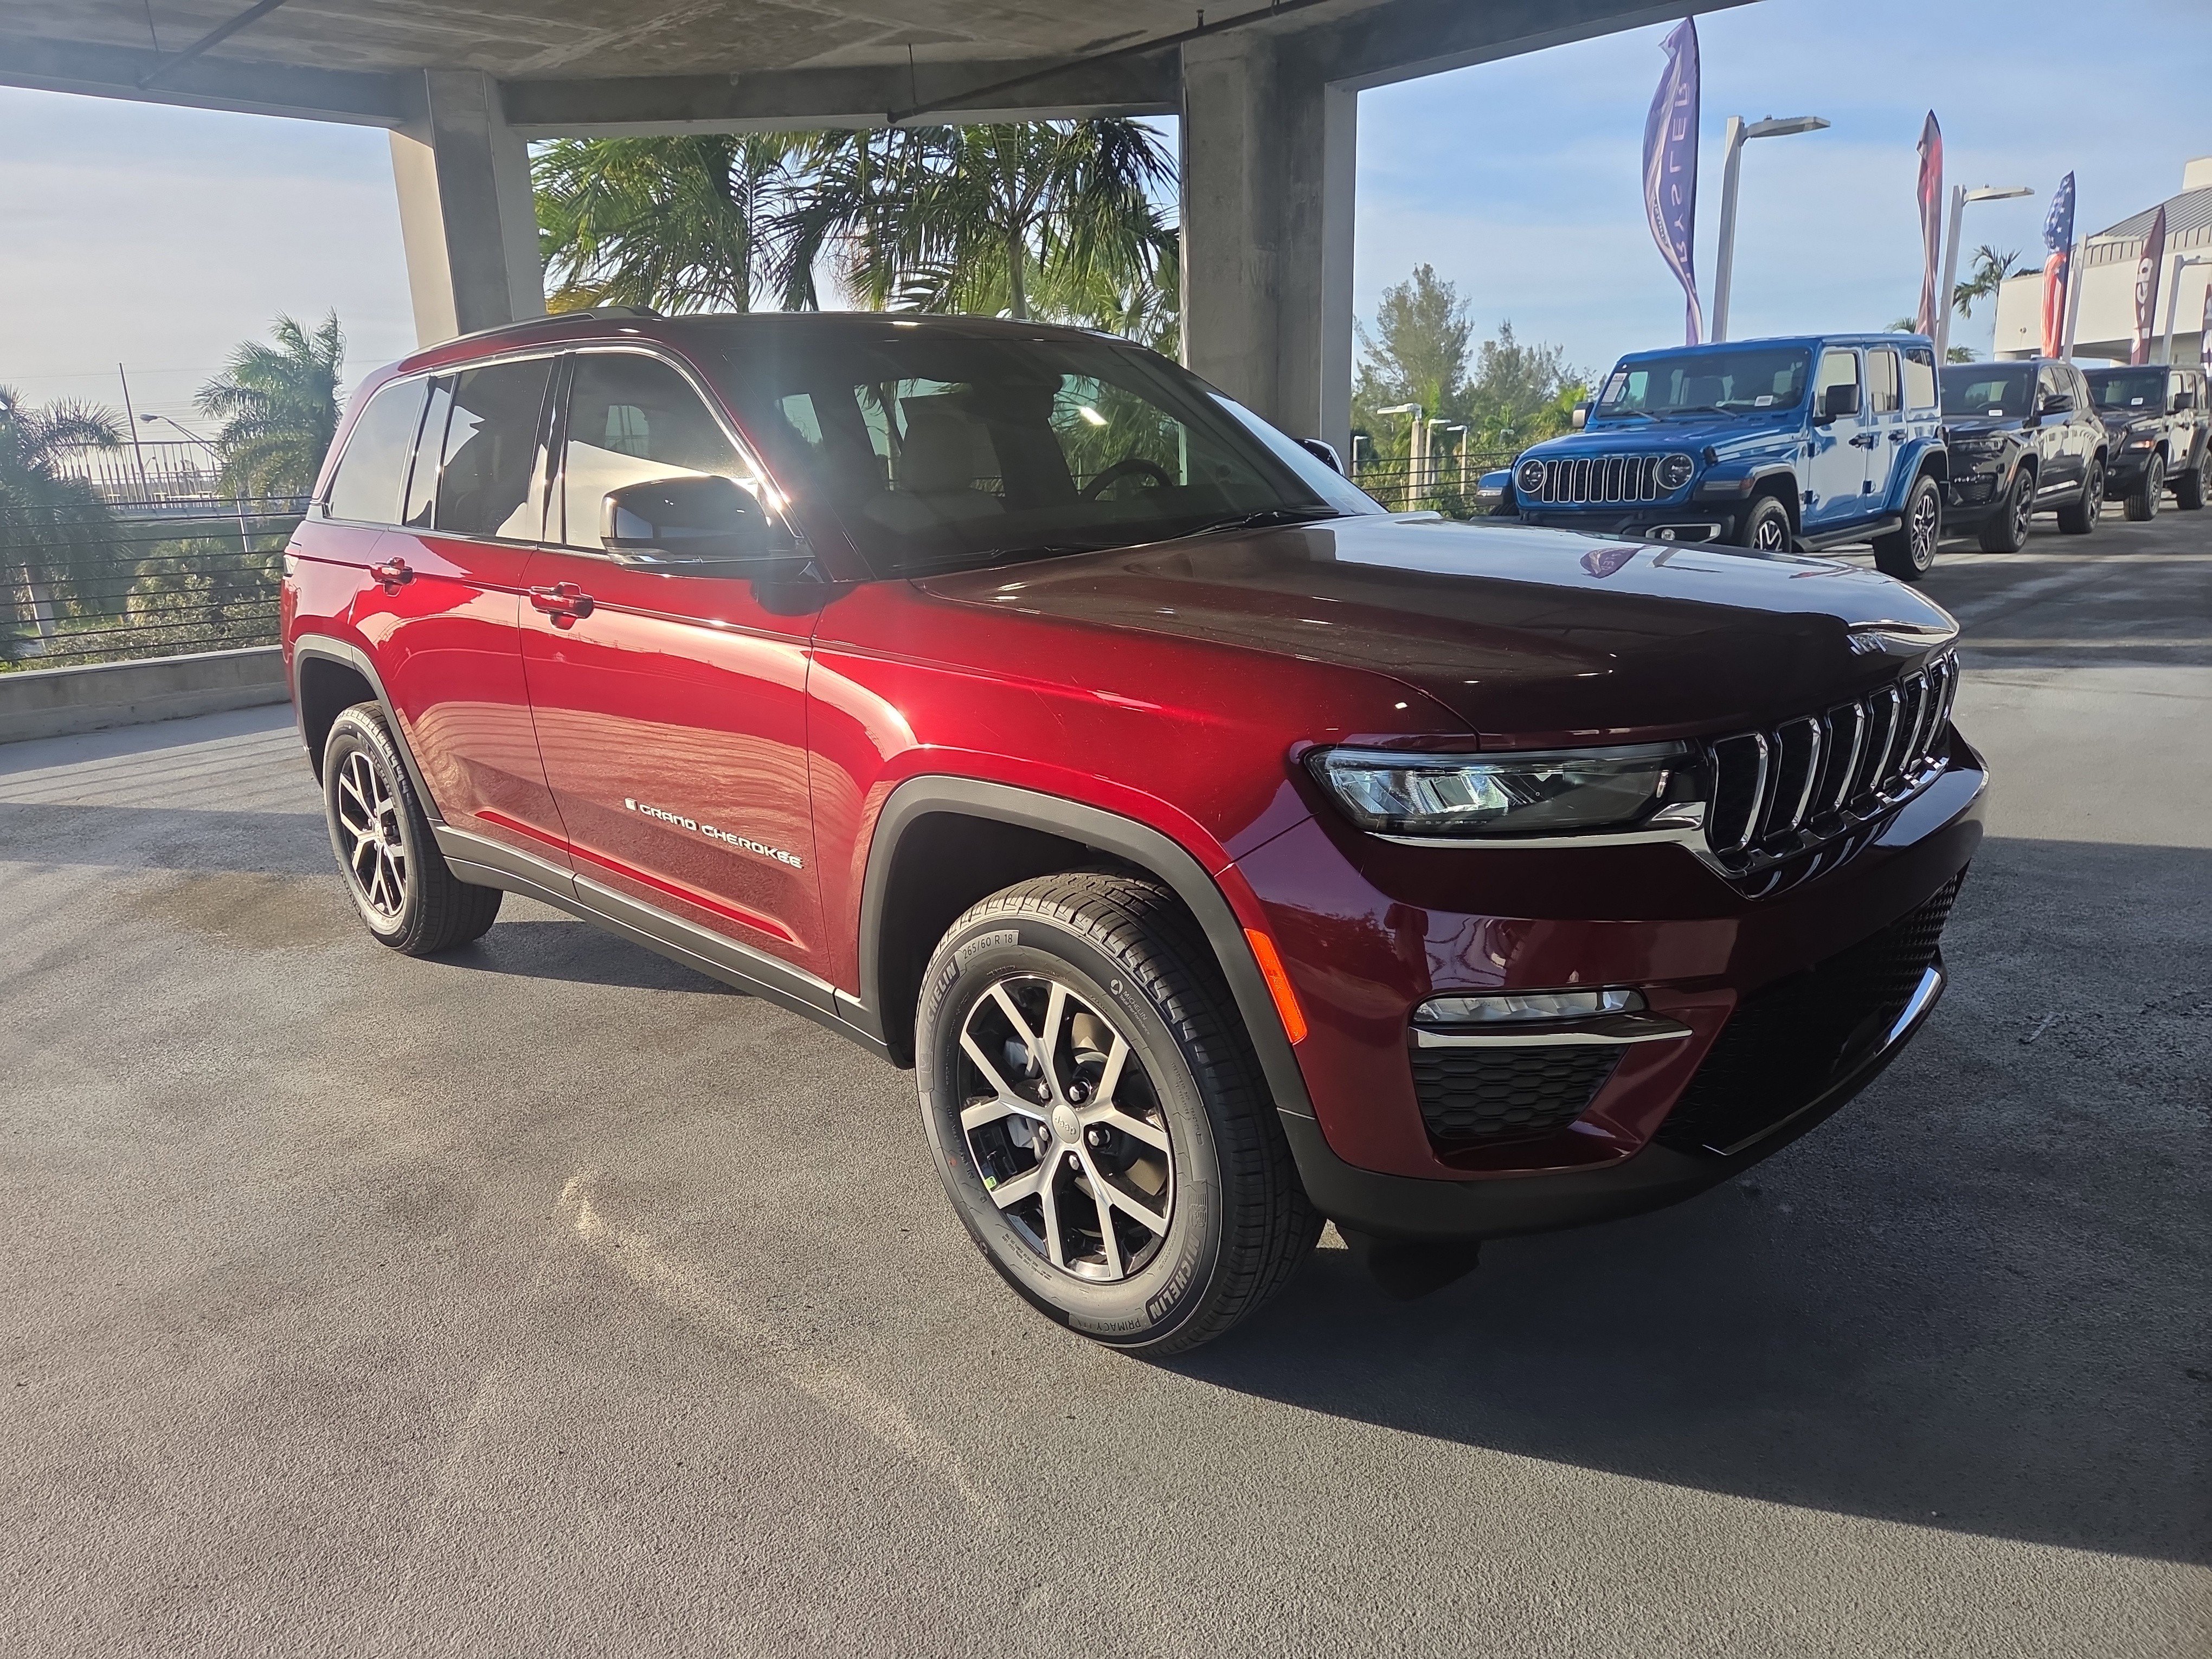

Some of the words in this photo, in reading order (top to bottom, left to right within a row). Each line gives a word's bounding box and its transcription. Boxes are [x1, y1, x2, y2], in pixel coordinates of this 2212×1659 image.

[639, 803, 698, 831] GRAND
[701, 825, 805, 869] CHEROKEE
[963, 937, 991, 960] 265/60
[994, 935, 1000, 945] R
[1004, 934, 1013, 944] 18
[1120, 994, 1131, 1007] Total
[1128, 1004, 1150, 1035] Performance
[1123, 990, 1148, 1021] MICHELIN
[1054, 1115, 1077, 1135] Jeep
[1149, 1234, 1201, 1320] MICHELIN
[1096, 1317, 1142, 1332] PRIMACY
